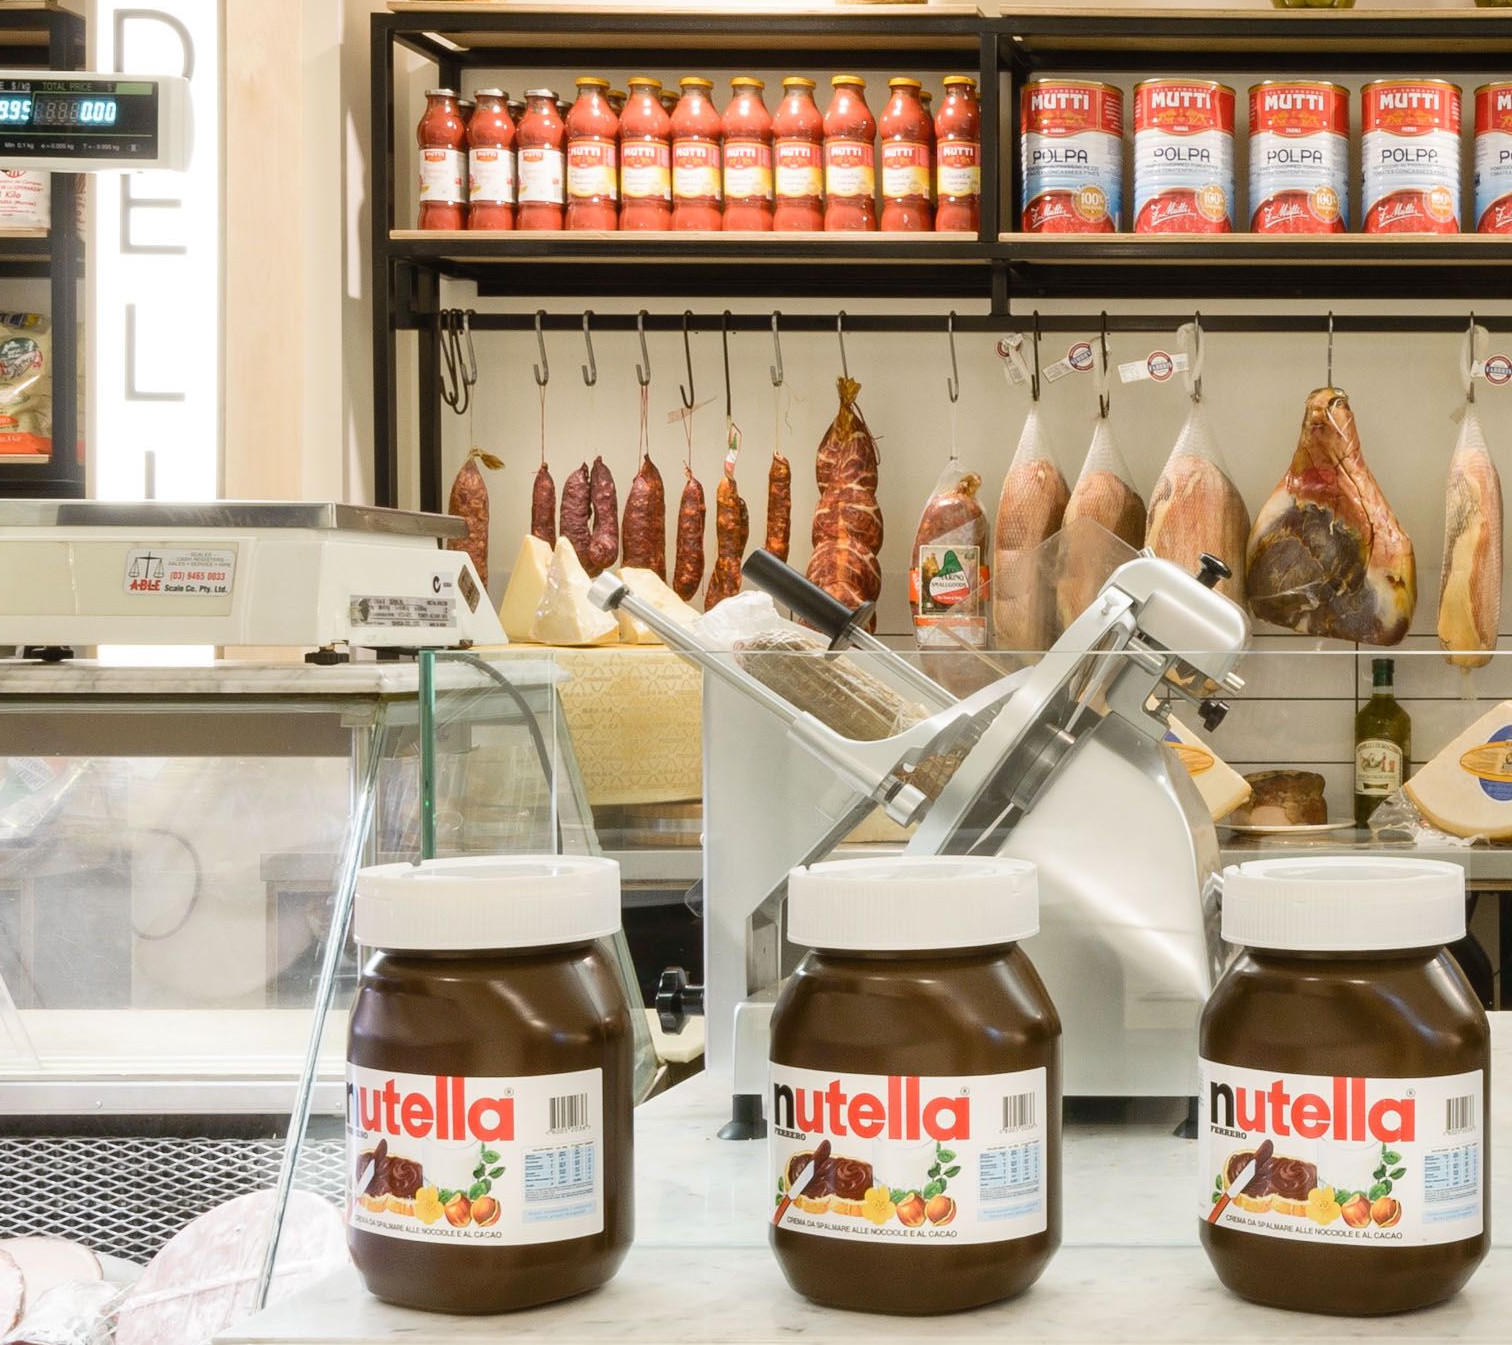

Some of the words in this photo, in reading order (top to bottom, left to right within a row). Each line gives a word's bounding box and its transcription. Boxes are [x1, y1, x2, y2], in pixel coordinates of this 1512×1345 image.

[43, 82, 68, 91] TOTAL
[70, 82, 92, 91] PRICE
[1032, 93, 1089, 111] MUTTI
[1151, 91, 1211, 109] MUTTI
[1264, 93, 1323, 111] MUTTI
[1380, 93, 1438, 111] MUTTI
[830, 146, 862, 156] MUTTI
[942, 146, 974, 156] MUTTI
[1032, 147, 1089, 165] POLPA
[1381, 148, 1438, 164] POLPA
[207, 572, 225, 580] 0033
[164, 584, 184, 592] Scale
[347, 1076, 514, 1142] nutella
[774, 1076, 970, 1141] nutella
[1211, 1076, 1415, 1143] nutella
[1210, 1125, 1247, 1140] FERRERO
